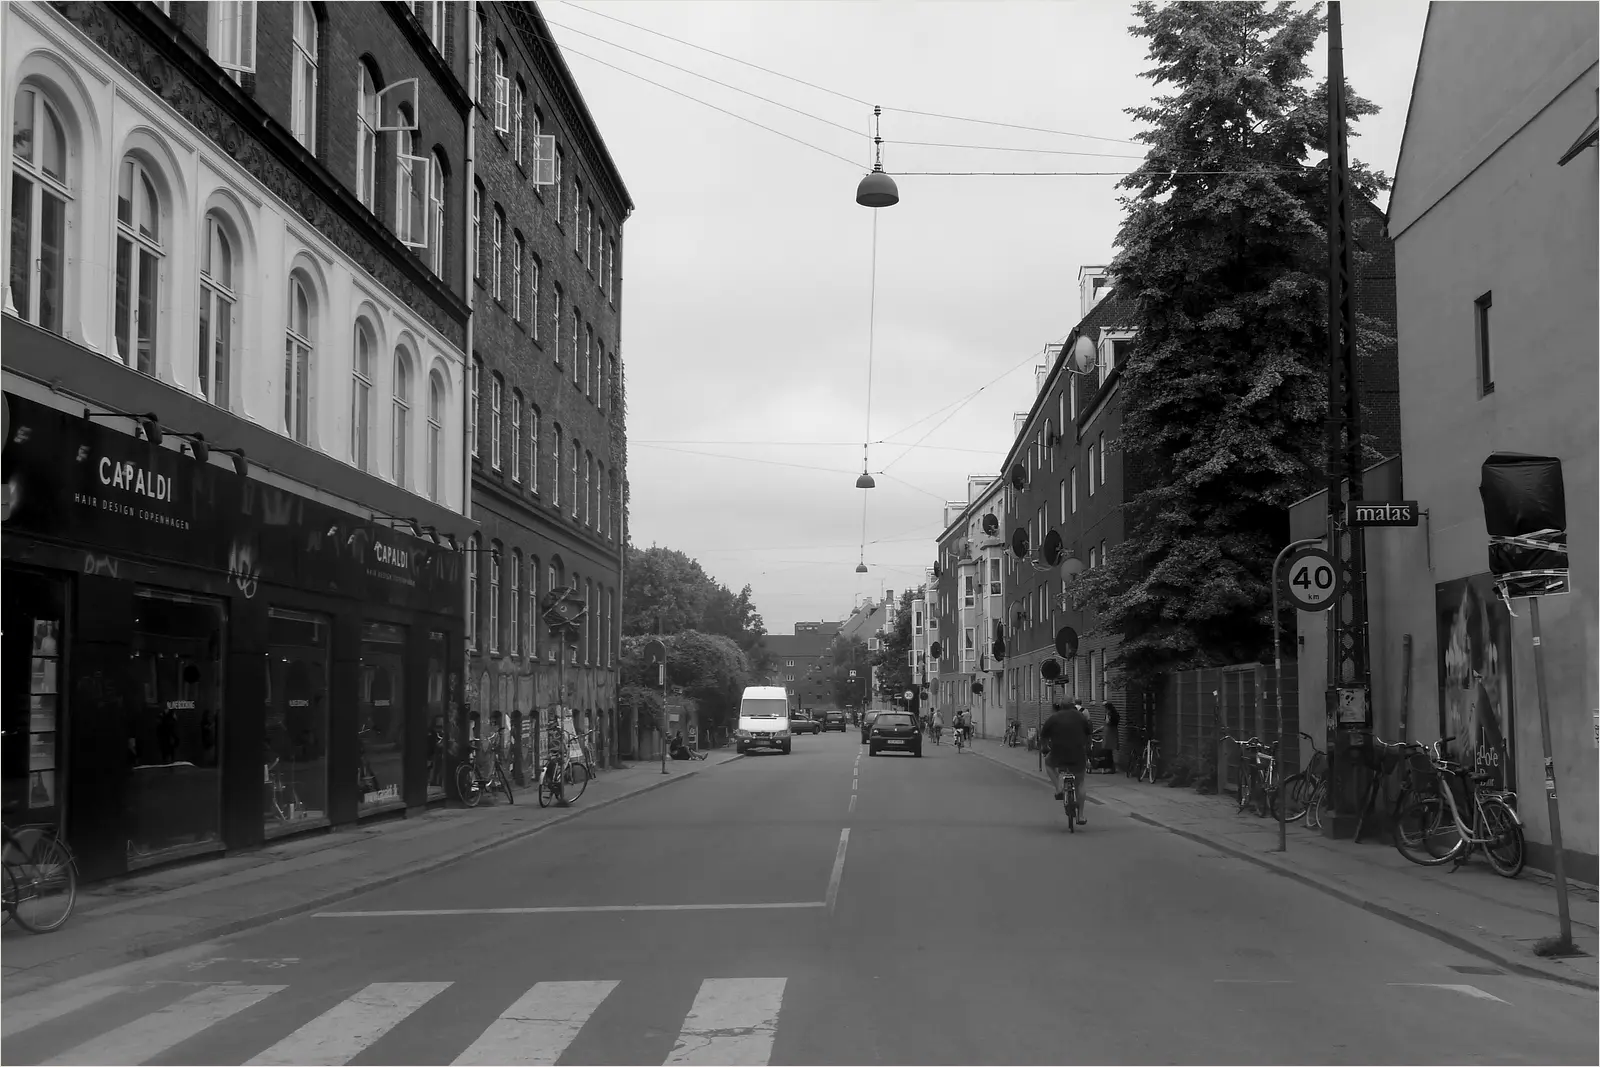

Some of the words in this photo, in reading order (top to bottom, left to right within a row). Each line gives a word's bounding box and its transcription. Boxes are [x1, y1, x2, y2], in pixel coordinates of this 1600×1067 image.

[99, 456, 171, 502] CAPALDI
[74, 493, 97, 507] HAIR
[102, 500, 135, 516] DESIGN
[139, 510, 189, 530] COPENHAGEN
[1355, 503, 1411, 521] matas
[376, 543, 408, 569] CAPALDI
[1292, 565, 1333, 590] 40
